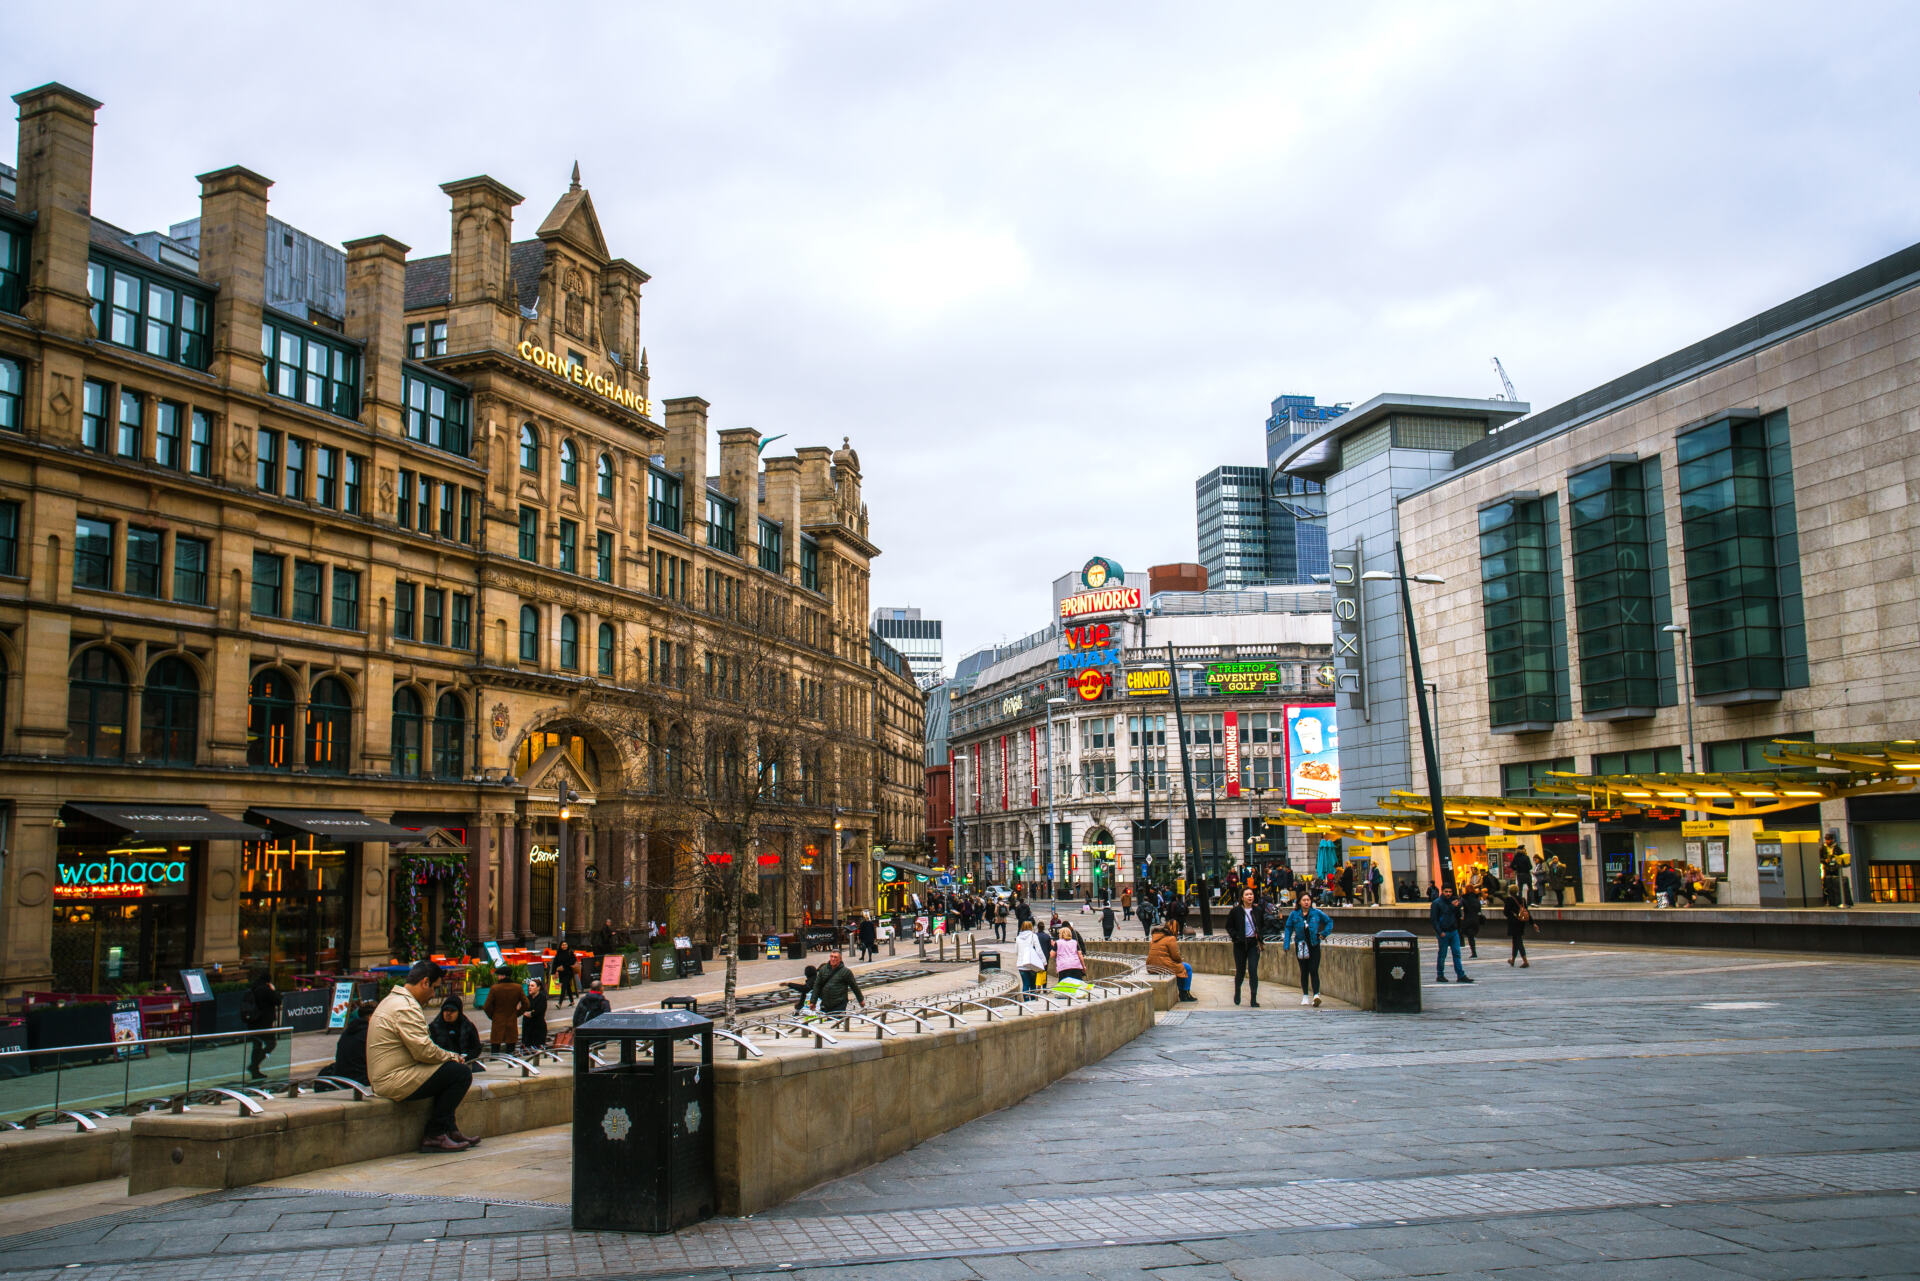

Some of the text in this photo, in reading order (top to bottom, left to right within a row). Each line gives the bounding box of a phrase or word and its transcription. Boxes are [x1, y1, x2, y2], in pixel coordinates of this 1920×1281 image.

[518, 340, 653, 417] CORN EXCHANGE
[1065, 589, 1139, 616] PRINTWORKS
[1334, 564, 1360, 689] next
[1058, 648, 1121, 670] IMAX
[1217, 664, 1267, 673] TREETOP
[1067, 673, 1112, 688] Hard Rock
[1127, 670, 1171, 689] CHIQUITO
[1208, 672, 1277, 682] ADVENTURE
[1228, 682, 1257, 691] GOLF
[58, 857, 186, 884] wahaca
[287, 1005, 324, 1017] wahaca
